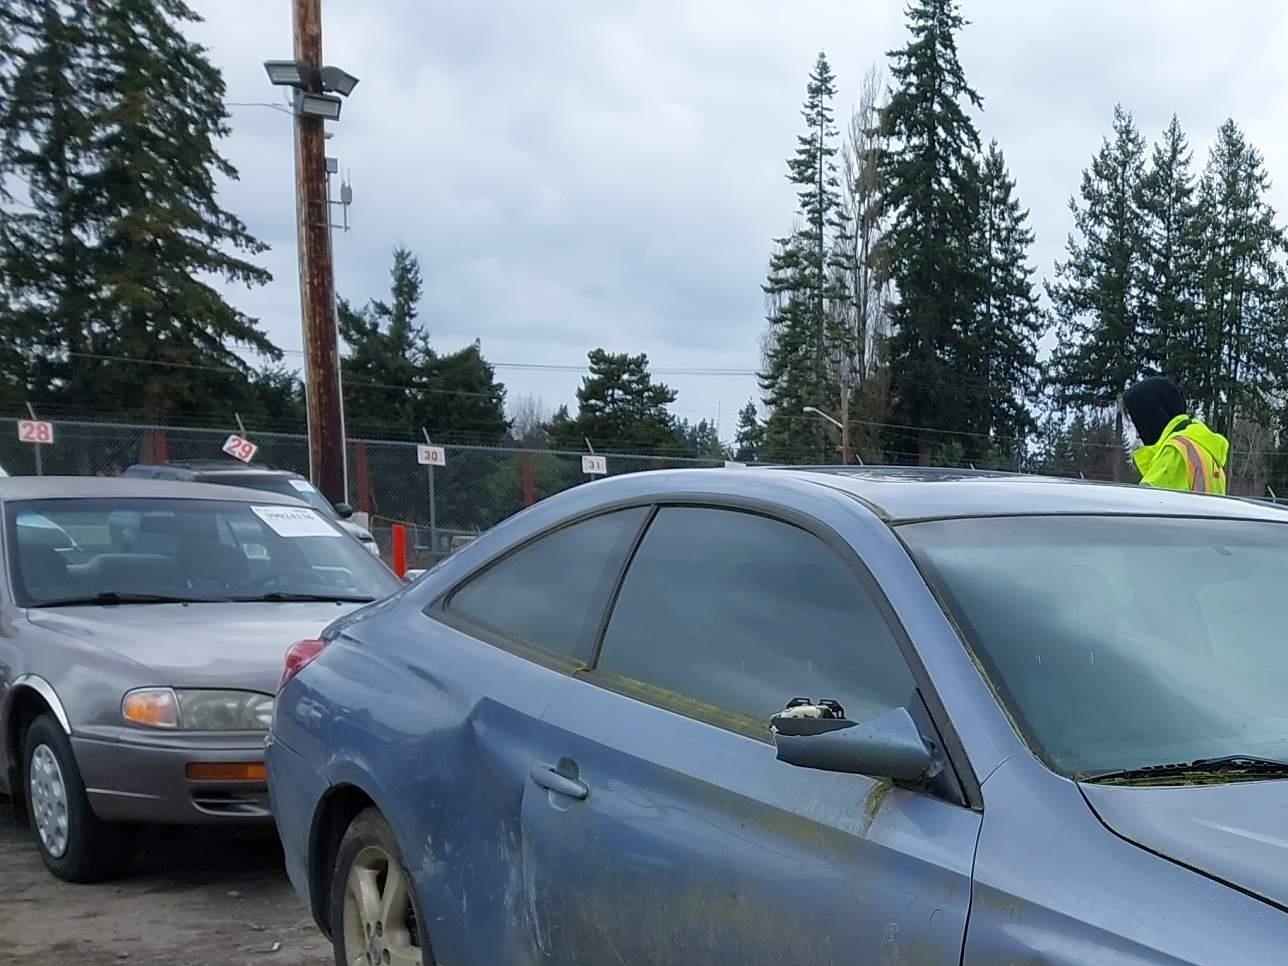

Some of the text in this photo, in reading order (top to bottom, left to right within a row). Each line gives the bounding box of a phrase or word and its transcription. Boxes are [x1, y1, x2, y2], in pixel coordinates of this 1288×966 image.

[22, 422, 48, 441] 28
[226, 438, 253, 459] 29
[424, 450, 438, 461] 30
